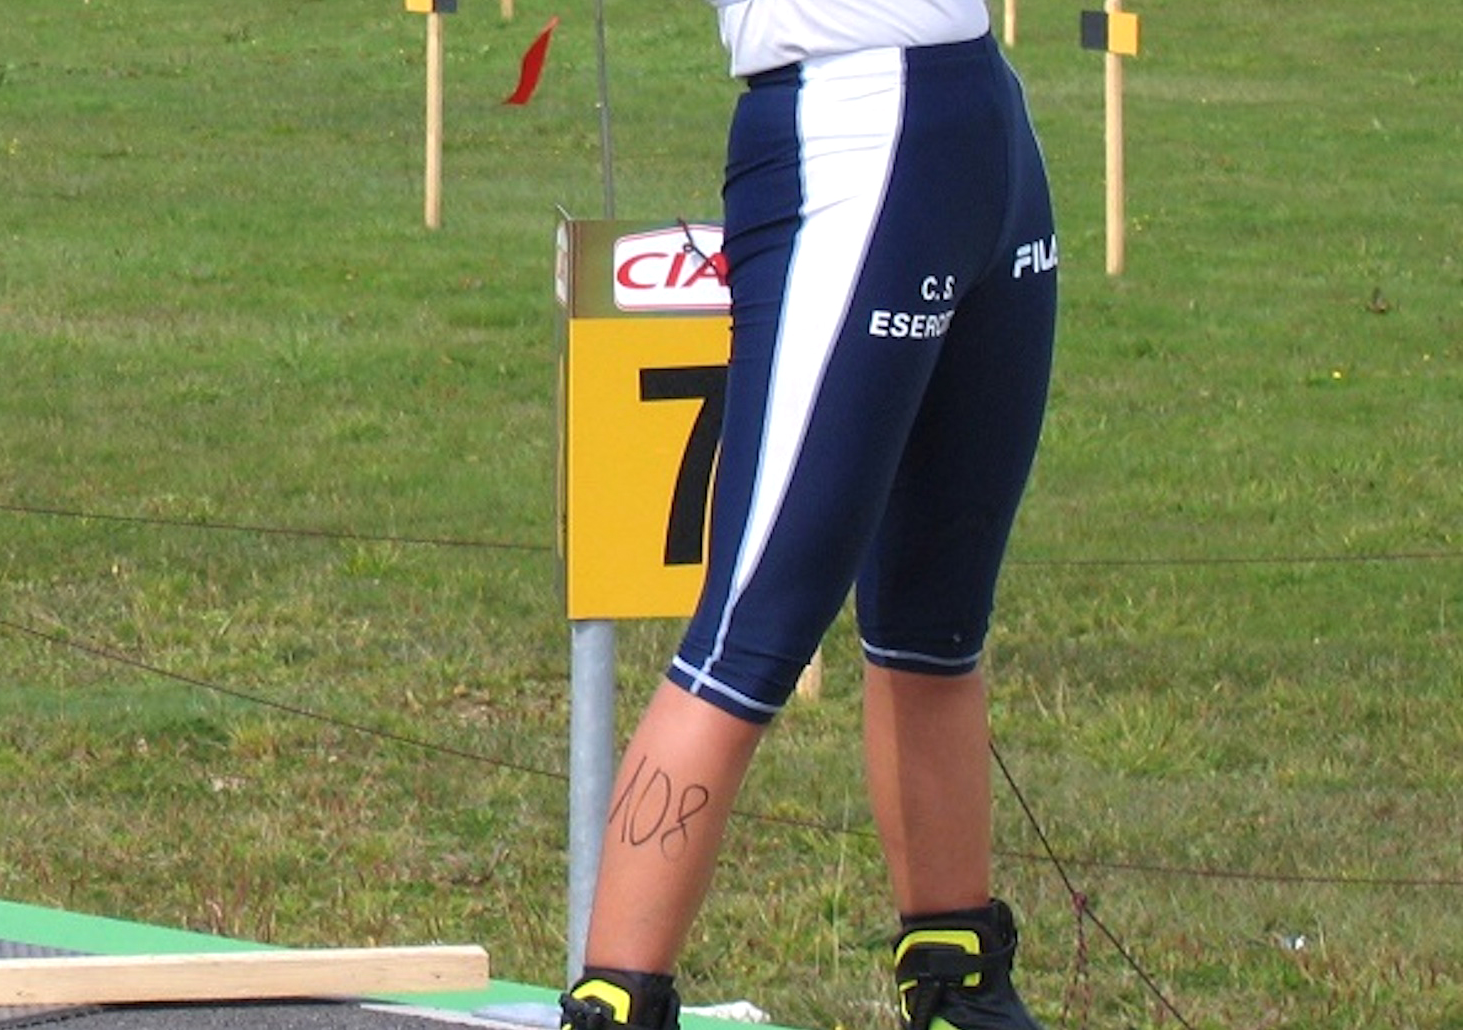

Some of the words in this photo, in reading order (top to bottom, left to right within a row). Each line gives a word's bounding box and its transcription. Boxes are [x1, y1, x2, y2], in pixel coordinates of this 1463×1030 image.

[616, 252, 730, 289] CIA
[639, 365, 731, 567] 7
[608, 755, 709, 862] 108
